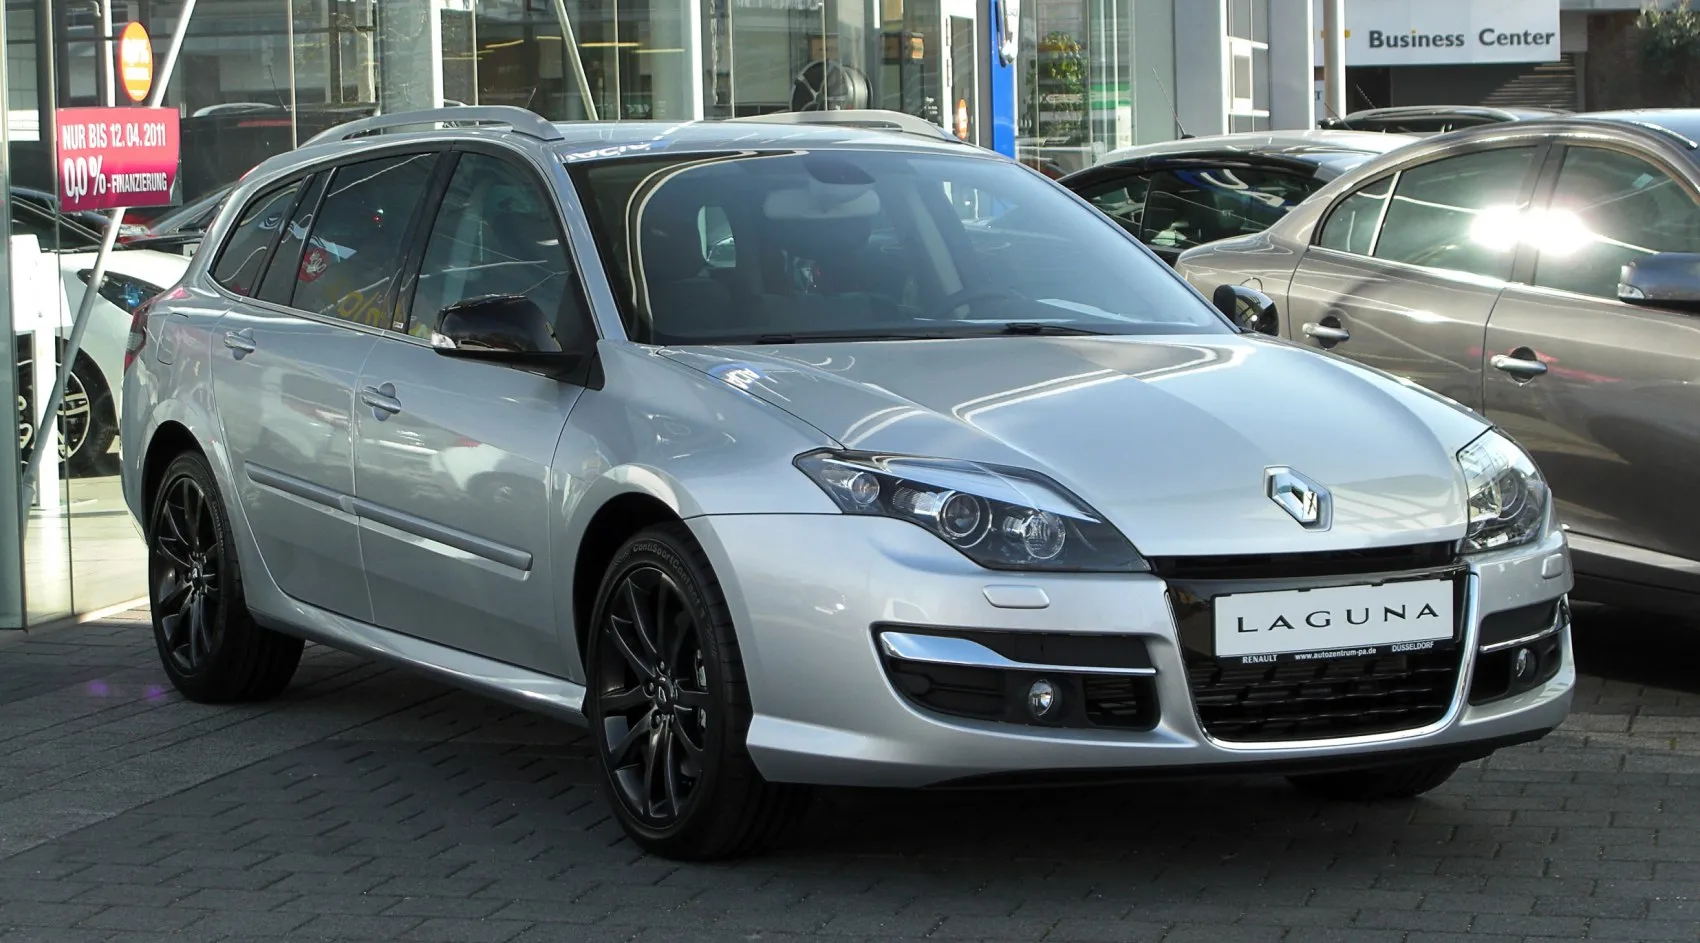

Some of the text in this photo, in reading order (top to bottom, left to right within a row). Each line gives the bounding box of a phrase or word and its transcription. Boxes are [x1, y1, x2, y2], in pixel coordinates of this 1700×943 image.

[1369, 28, 1556, 49] Business Center
[62, 124, 86, 150] NUR
[88, 123, 107, 149] BIS
[1236, 603, 1440, 633] LAGUNA
[1242, 654, 1278, 664] RENAULT
[1294, 647, 1377, 661] www.autozentrum-pa.de
